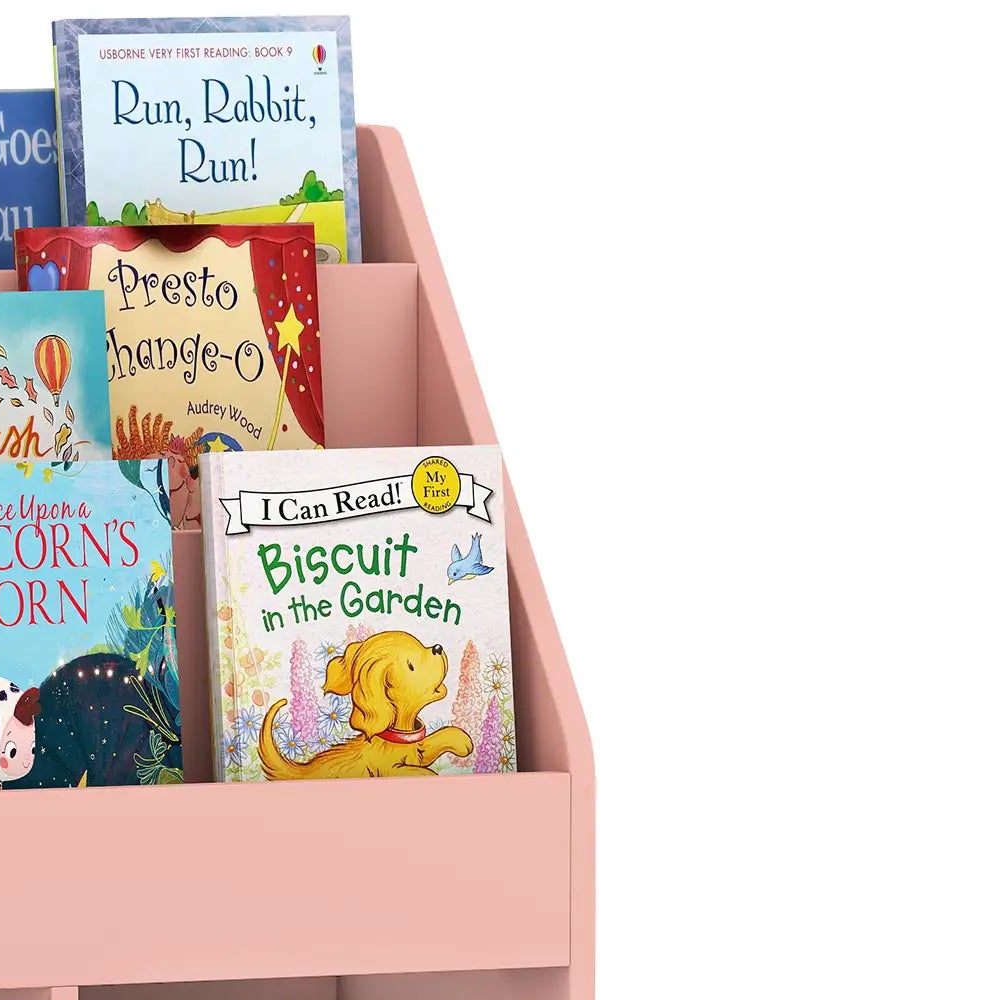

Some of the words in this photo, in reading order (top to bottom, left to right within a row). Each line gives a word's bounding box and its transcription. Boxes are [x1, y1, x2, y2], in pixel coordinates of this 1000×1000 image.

[99, 48, 146, 60] USBORNE
[149, 48, 173, 60] VERY
[176, 47, 201, 59] FIRST
[204, 46, 251, 59] READING:
[254, 46, 284, 58] BOOK
[286, 46, 293, 57] 9
[112, 79, 192, 131] Run,
[202, 74, 316, 129] Rabbit,
[178, 137, 258, 184] Run!
[107, 258, 238, 311] Presto
[187, 399, 227, 420] Audrey
[229, 404, 263, 440] Wood
[422, 459, 449, 469] SHARED
[425, 471, 446, 485] My
[261, 498, 271, 521] I
[278, 496, 328, 523] Can
[333, 482, 402, 515] Read!
[423, 486, 450, 498] First
[423, 500, 452, 512] READING
[19, 494, 76, 538] Upon
[78, 501, 92, 519] a
[257, 533, 418, 595] Biscuit
[262, 609, 284, 632] in
[287, 595, 332, 623] the
[340, 581, 462, 626] Garden
